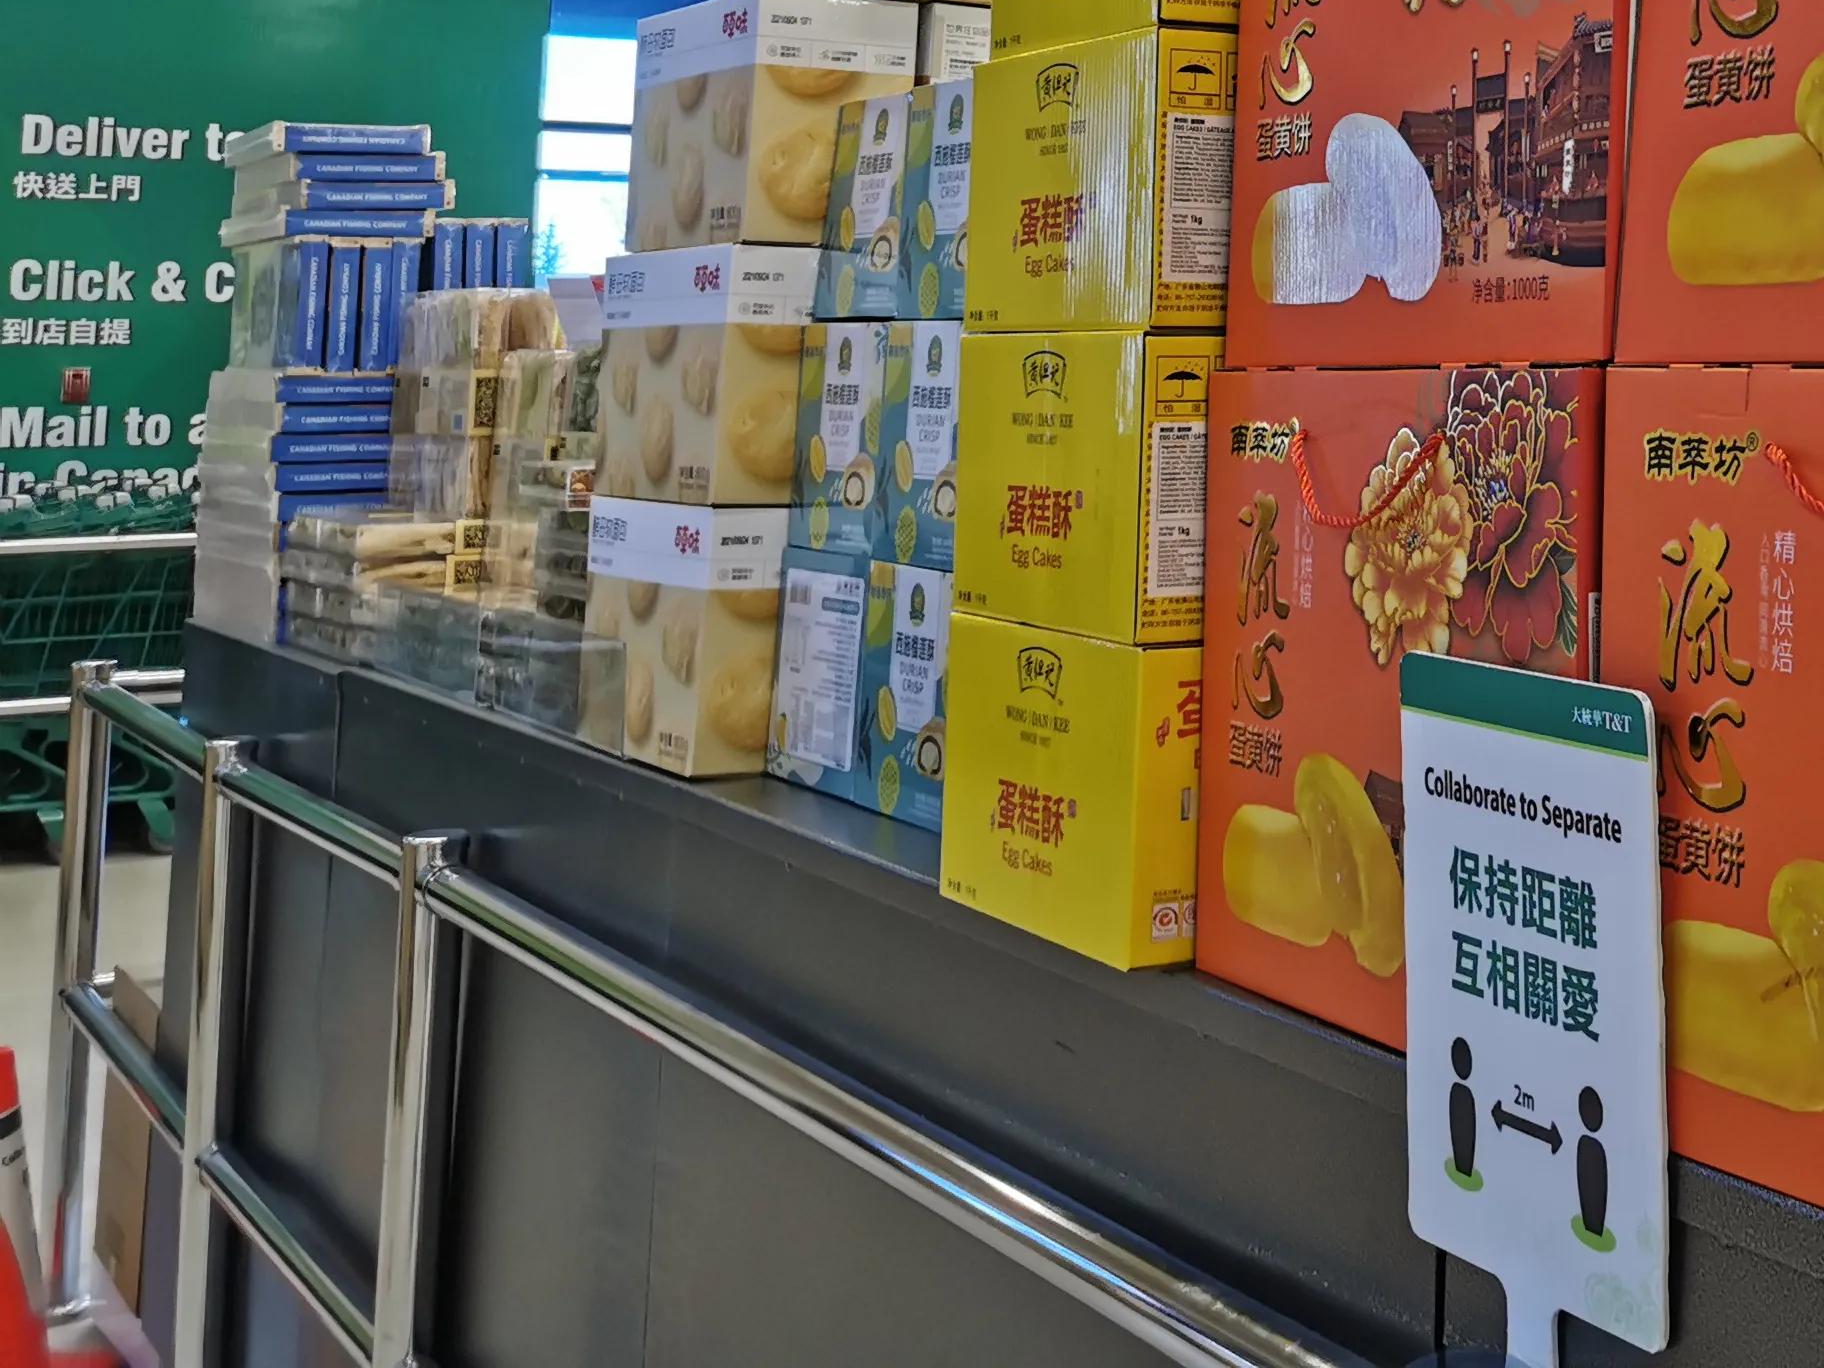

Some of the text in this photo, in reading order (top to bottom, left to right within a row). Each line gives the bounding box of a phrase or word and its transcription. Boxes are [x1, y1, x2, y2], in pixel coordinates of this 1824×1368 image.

[1683, 45, 1776, 110] 蛋黄饼
[21, 113, 190, 161] Deliver
[1255, 110, 1314, 162] 蛋黄饼
[13, 171, 141, 201] 快送上門
[1190, 214, 1203, 226] 1kg
[10, 258, 136, 302] Click
[151, 260, 187, 303] &
[1024, 255, 1043, 279] Egg
[1, 318, 132, 346] 到店自提
[1, 406, 108, 448] Mail
[125, 406, 172, 447] to
[1006, 484, 1073, 541] 蛋糕酥
[1177, 526, 1191, 537] 1kg
[1011, 544, 1063, 570] Egg Cakes
[1771, 530, 1797, 674] 精心烘焙
[996, 778, 1065, 849] 蛋糕酥
[1424, 765, 1623, 844] Collaborate to Separate
[1001, 840, 1053, 877] Egg Cakes
[1448, 845, 1599, 952] 保持距離
[1450, 929, 1600, 1043] 互相關愛
[1513, 1084, 1536, 1111] 2m
